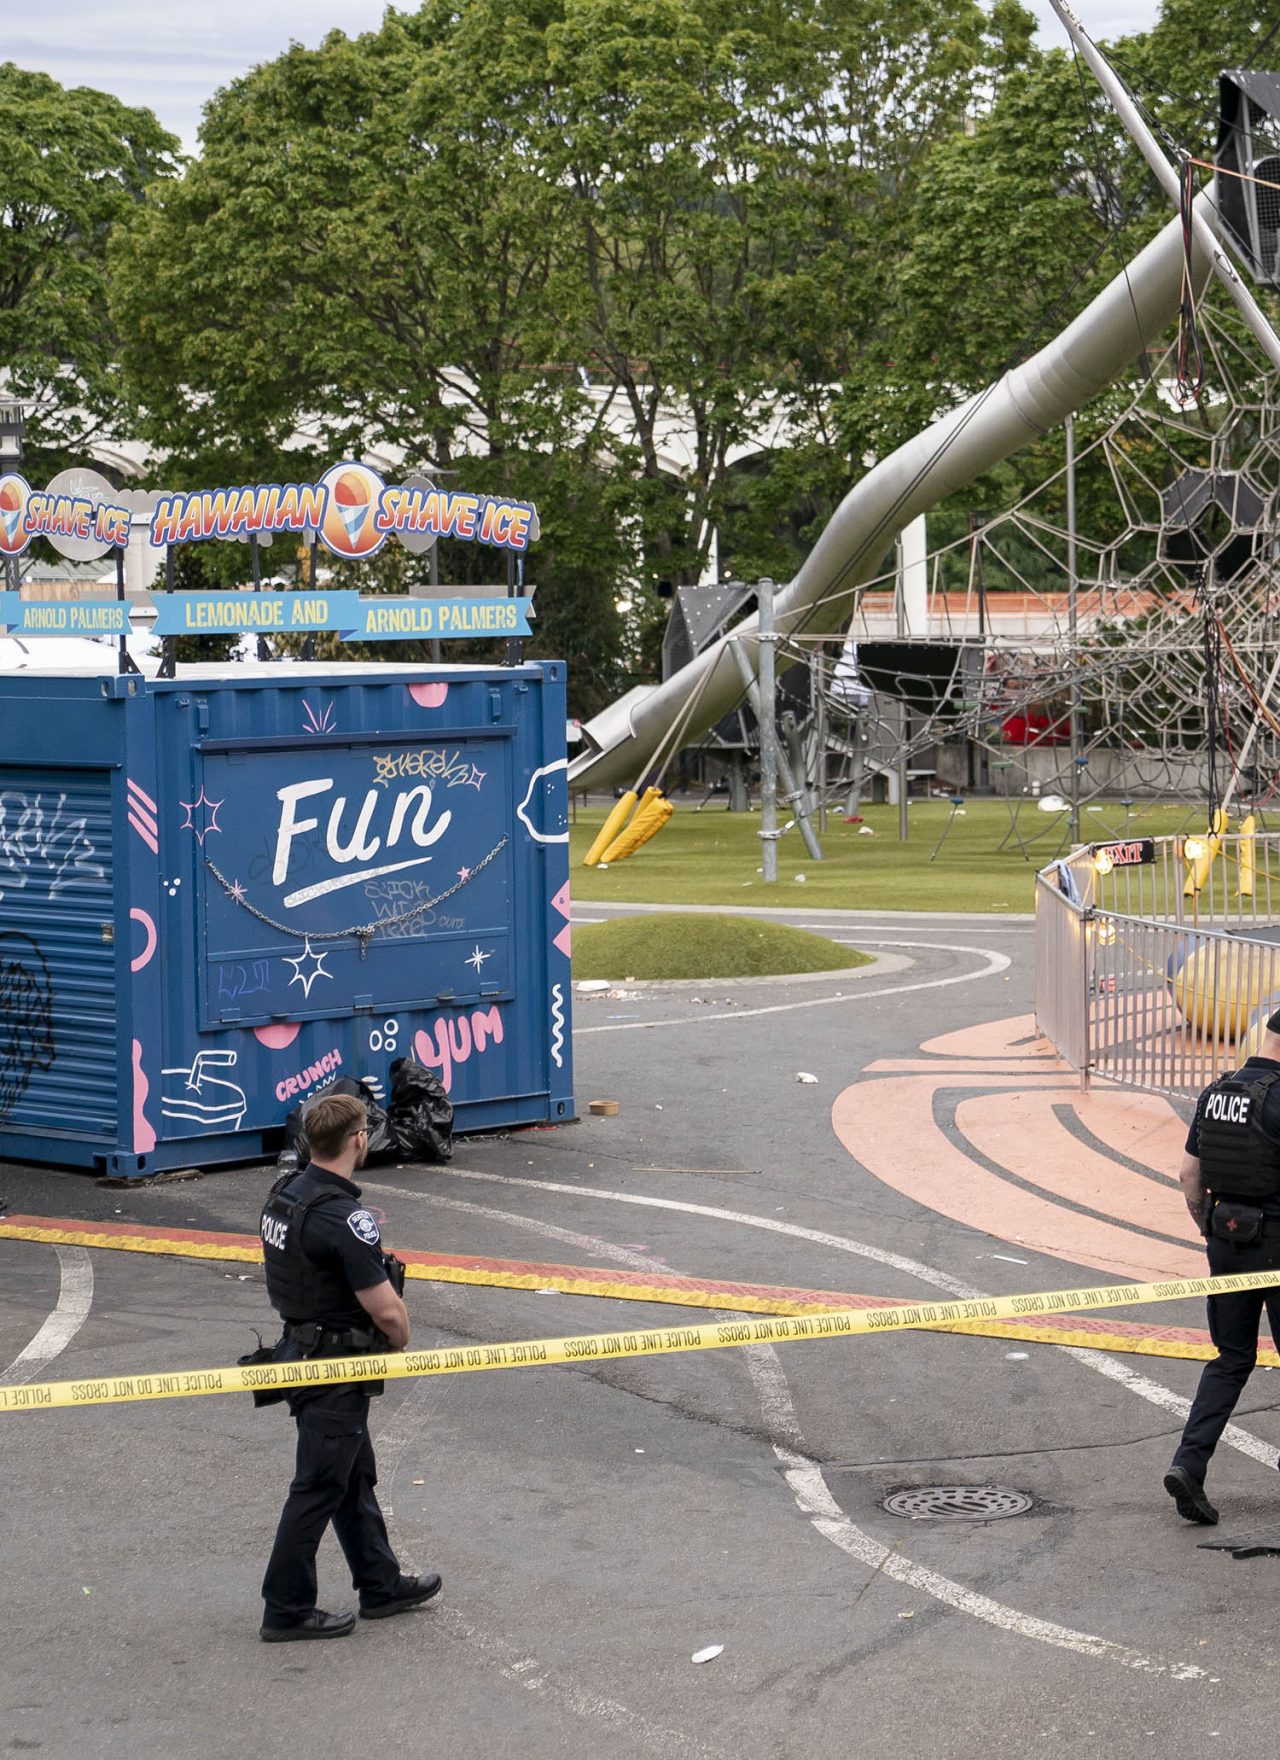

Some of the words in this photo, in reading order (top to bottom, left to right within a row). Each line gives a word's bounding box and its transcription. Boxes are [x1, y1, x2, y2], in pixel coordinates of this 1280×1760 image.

[25, 496, 92, 538] SHAVE
[96, 504, 130, 546] ICE
[154, 486, 325, 545] HAWAIIAN
[378, 486, 479, 539] SHAVE
[481, 501, 532, 550] ICE
[23, 607, 67, 629] ARNOLD
[70, 606, 124, 629] PALMERS
[185, 601, 285, 629] LEMONADE
[291, 598, 328, 625] AND
[365, 606, 432, 634] ARNOLD
[439, 603, 517, 631] PALMERS
[272, 777, 453, 886] Fun
[275, 1048, 343, 1102] CRUNCH
[1204, 1093, 1250, 1124] POLICE
[261, 1214, 288, 1250] POLICE
[1188, 1279, 1207, 1294] NOT
[1209, 1278, 1222, 1291] DO
[1225, 1276, 1245, 1290] LINE
[1248, 1273, 1279, 1287] POLICE
[1084, 1291, 1103, 1305] LINE
[1106, 1287, 1140, 1303] POLICE
[1152, 1282, 1185, 1297] CROSS
[1011, 1297, 1044, 1313] CROSS
[1047, 1295, 1065, 1309] NOT
[1068, 1293, 1080, 1307] DO
[903, 1309, 921, 1324] NOT
[924, 1307, 937, 1322] DO
[940, 1304, 960, 1320] LINE
[964, 1301, 996, 1319] POLICE
[793, 1319, 813, 1335] LINE
[816, 1316, 850, 1333] POLICE
[867, 1311, 899, 1328] CROSS
[718, 1325, 750, 1342] CROSS
[754, 1323, 773, 1339] NOT
[776, 1321, 789, 1336] DO
[601, 1338, 620, 1354] NOT
[624, 1336, 637, 1351] DO
[641, 1333, 663, 1350] LINE
[666, 1330, 700, 1348] POLICE
[485, 1347, 507, 1364] LINE
[511, 1345, 546, 1362] POLICE
[564, 1340, 597, 1357] CROSS
[406, 1354, 440, 1372] CROSS
[444, 1352, 464, 1368] NOT
[467, 1350, 482, 1366] DO
[281, 1366, 300, 1383] NOT
[305, 1365, 319, 1380] DO
[324, 1362, 346, 1379] LINE
[350, 1359, 387, 1377] POLICE
[157, 1376, 180, 1393] LINE
[184, 1373, 222, 1391] POLICE
[241, 1369, 277, 1386] CROSS
[71, 1383, 108, 1401] CROSS
[113, 1381, 133, 1397] NOT
[138, 1379, 152, 1395] DO
[12, 1387, 52, 1406] POLICE
